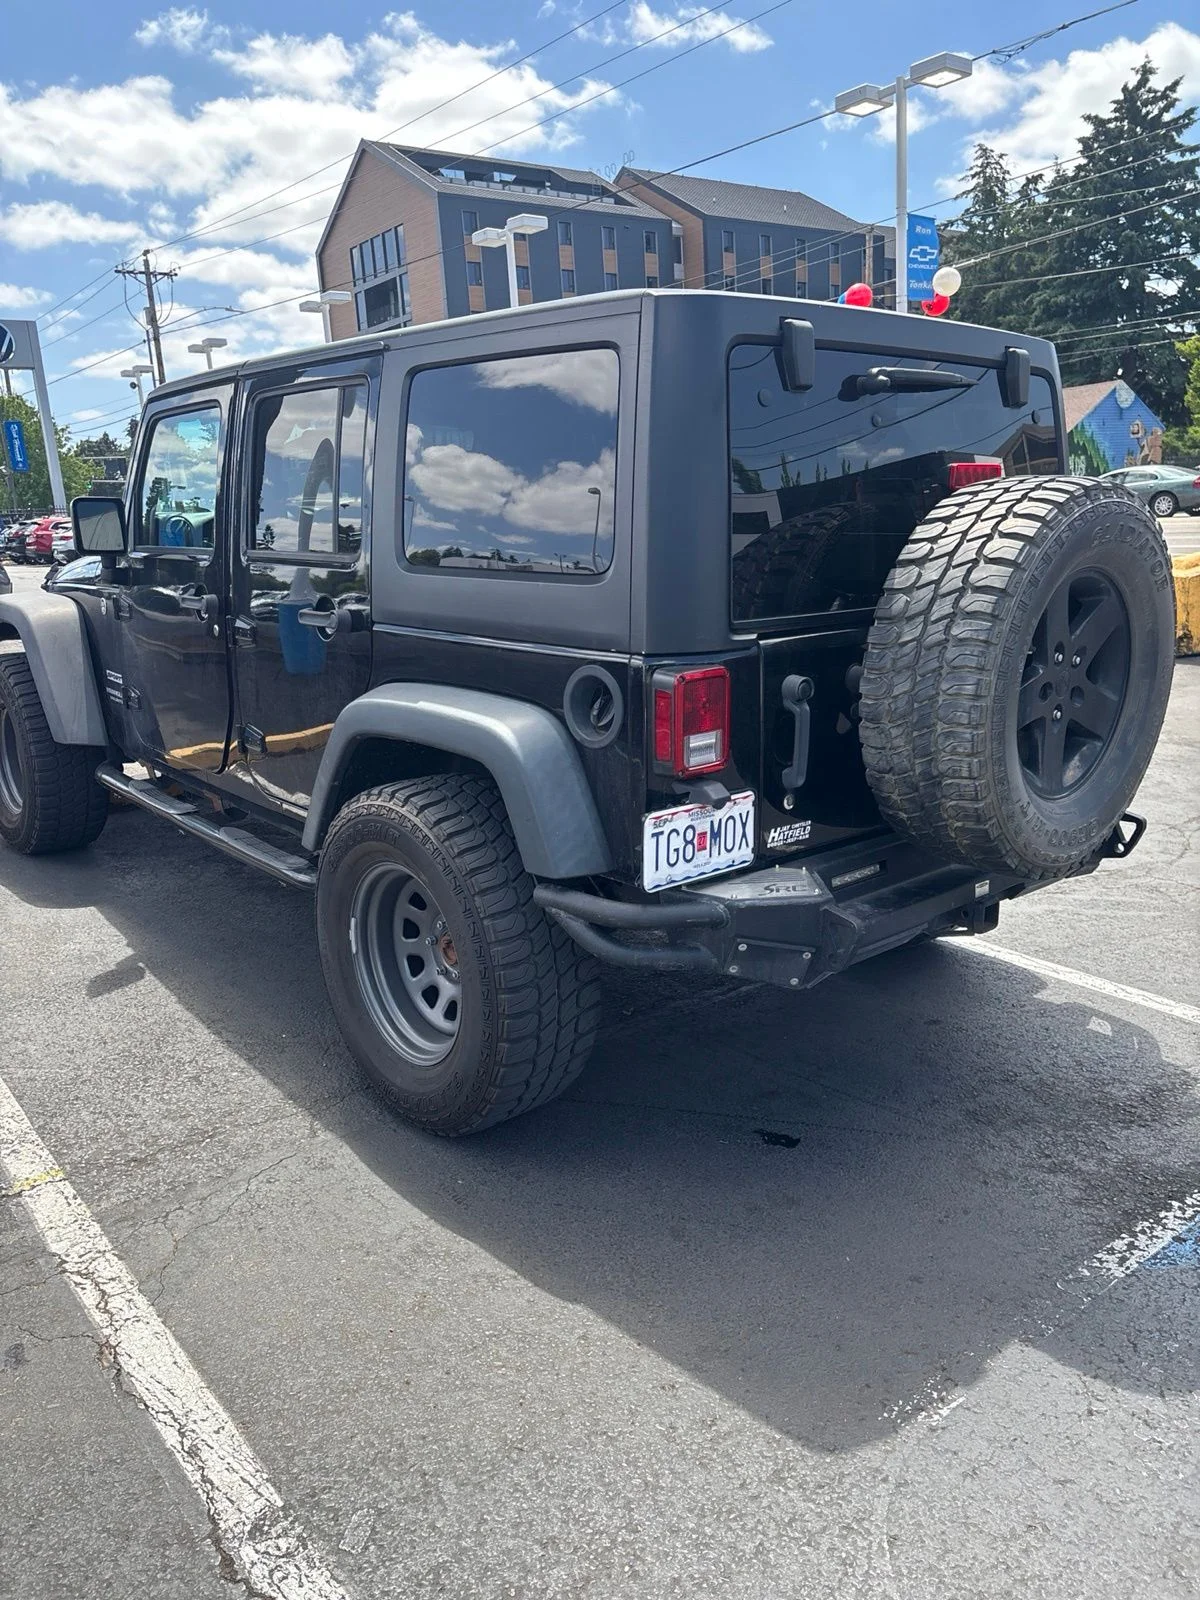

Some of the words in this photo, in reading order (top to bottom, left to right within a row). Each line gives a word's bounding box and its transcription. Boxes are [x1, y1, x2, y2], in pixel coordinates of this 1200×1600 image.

[915, 225, 931, 235] Ron
[688, 807, 716, 817] MISSOU
[768, 826, 811, 843] HATFIELD
[650, 824, 696, 873] TG8
